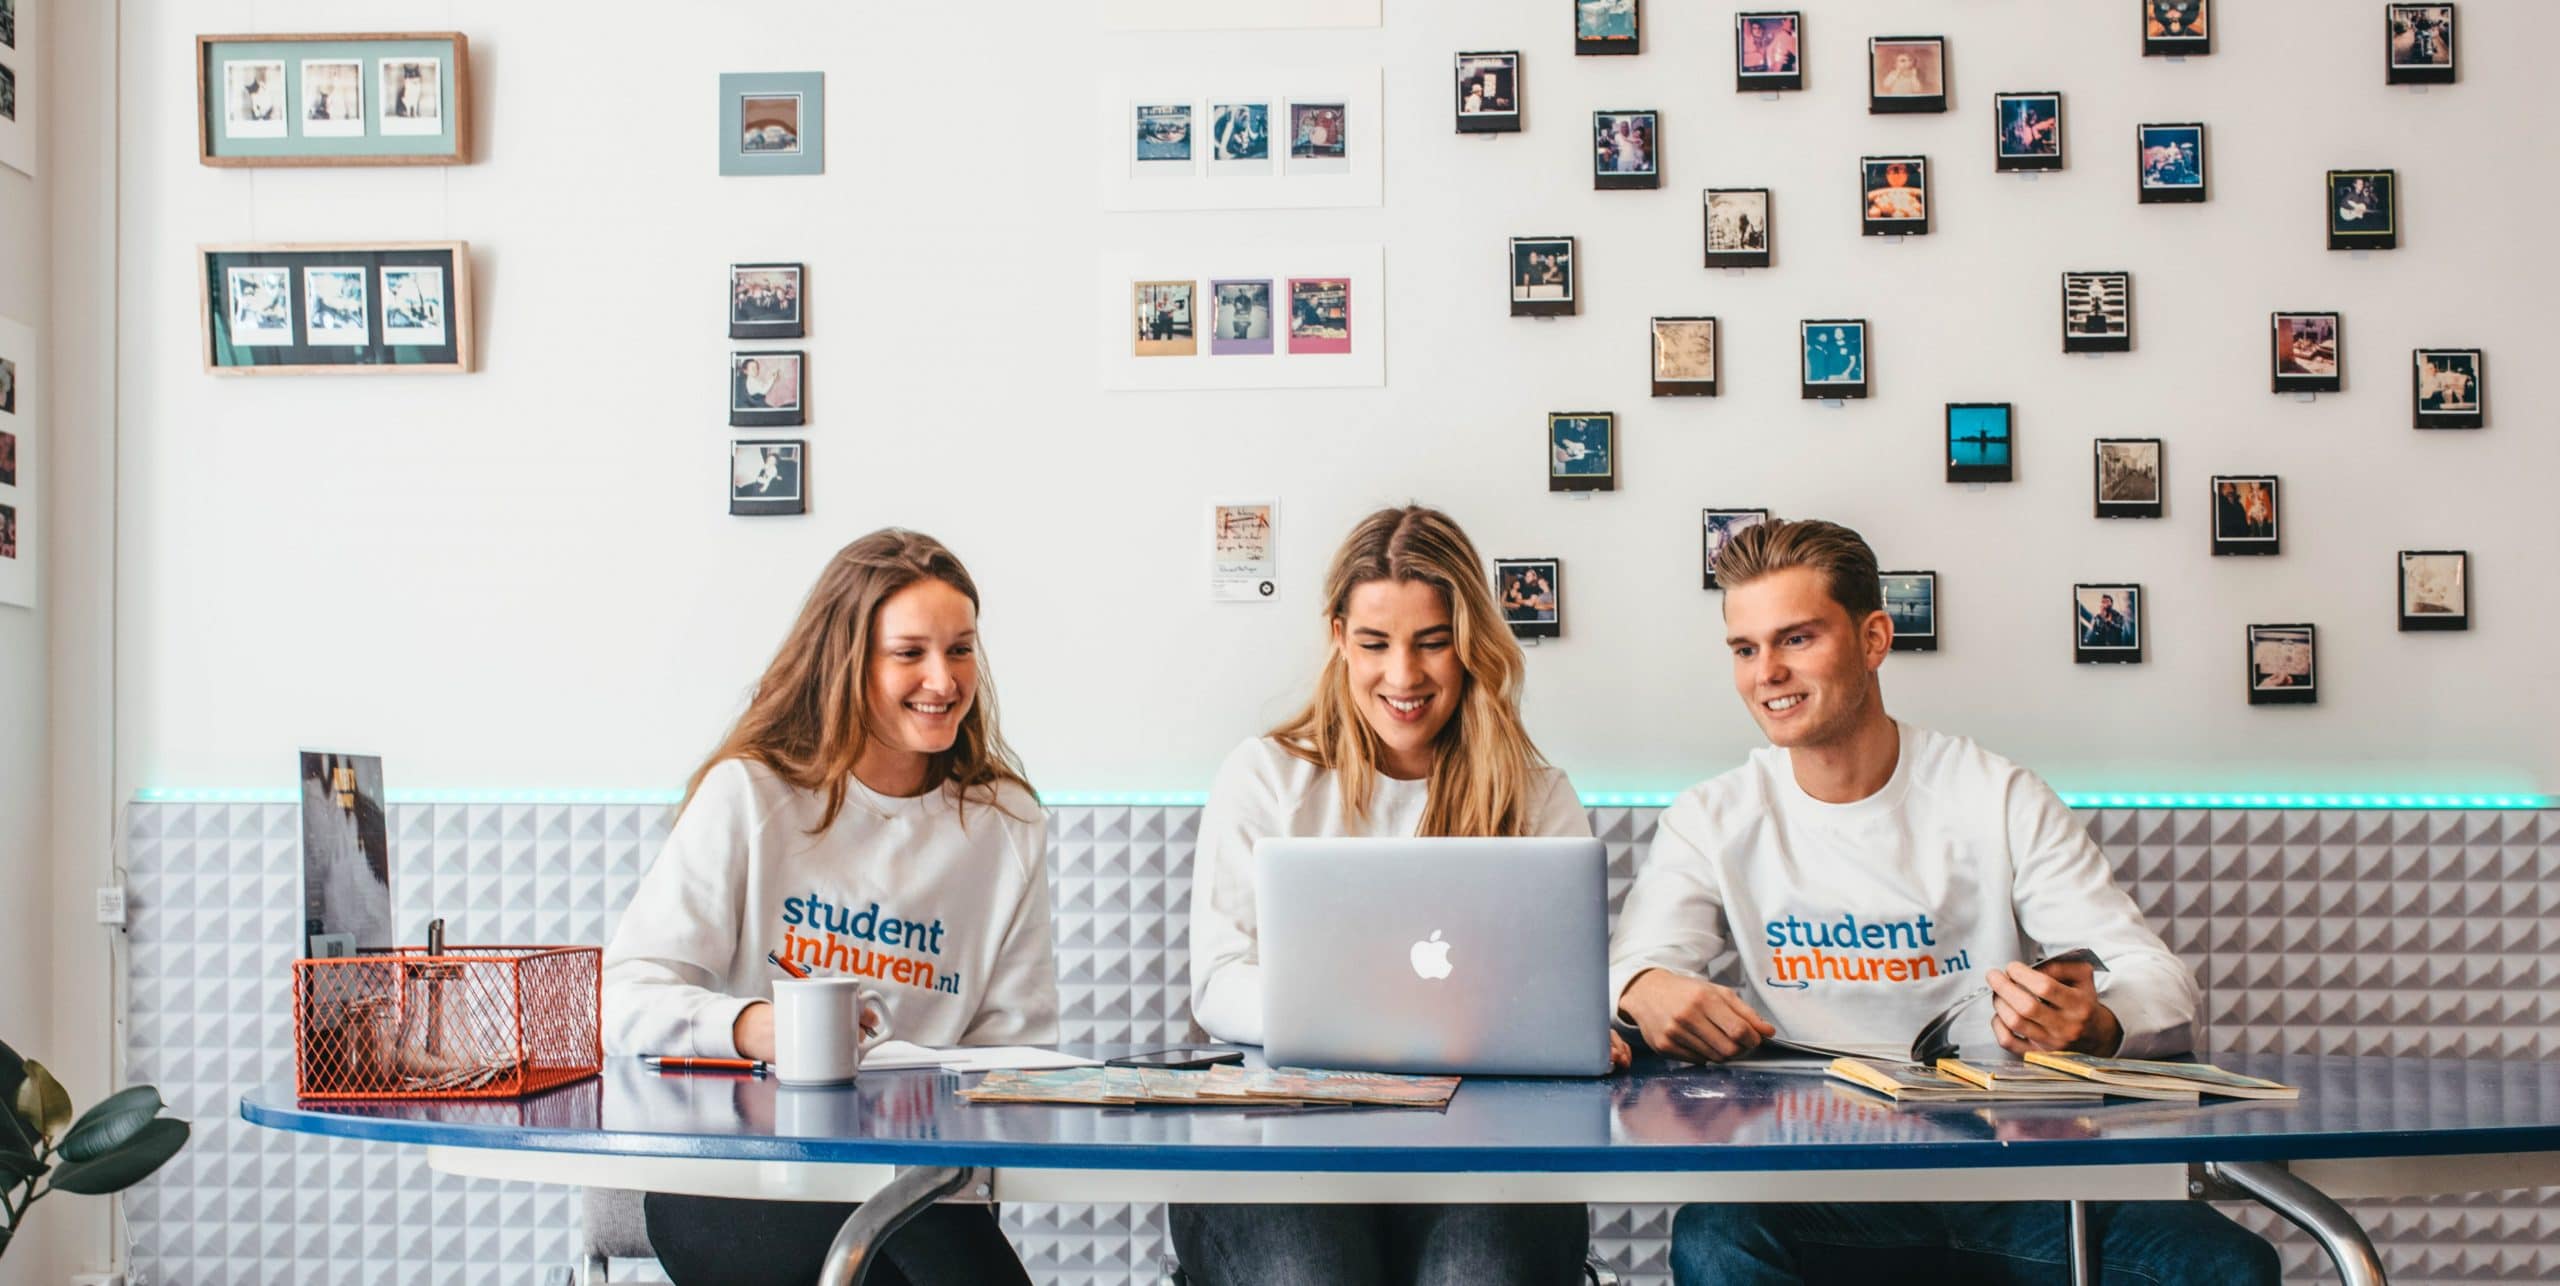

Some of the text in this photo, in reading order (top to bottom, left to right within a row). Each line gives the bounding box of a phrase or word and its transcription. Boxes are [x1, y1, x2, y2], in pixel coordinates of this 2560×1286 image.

[782, 893, 944, 954] student
[1766, 913, 1936, 949] student
[784, 925, 960, 994] inhuren.nl
[1773, 948, 1971, 981] inhuren.nl
